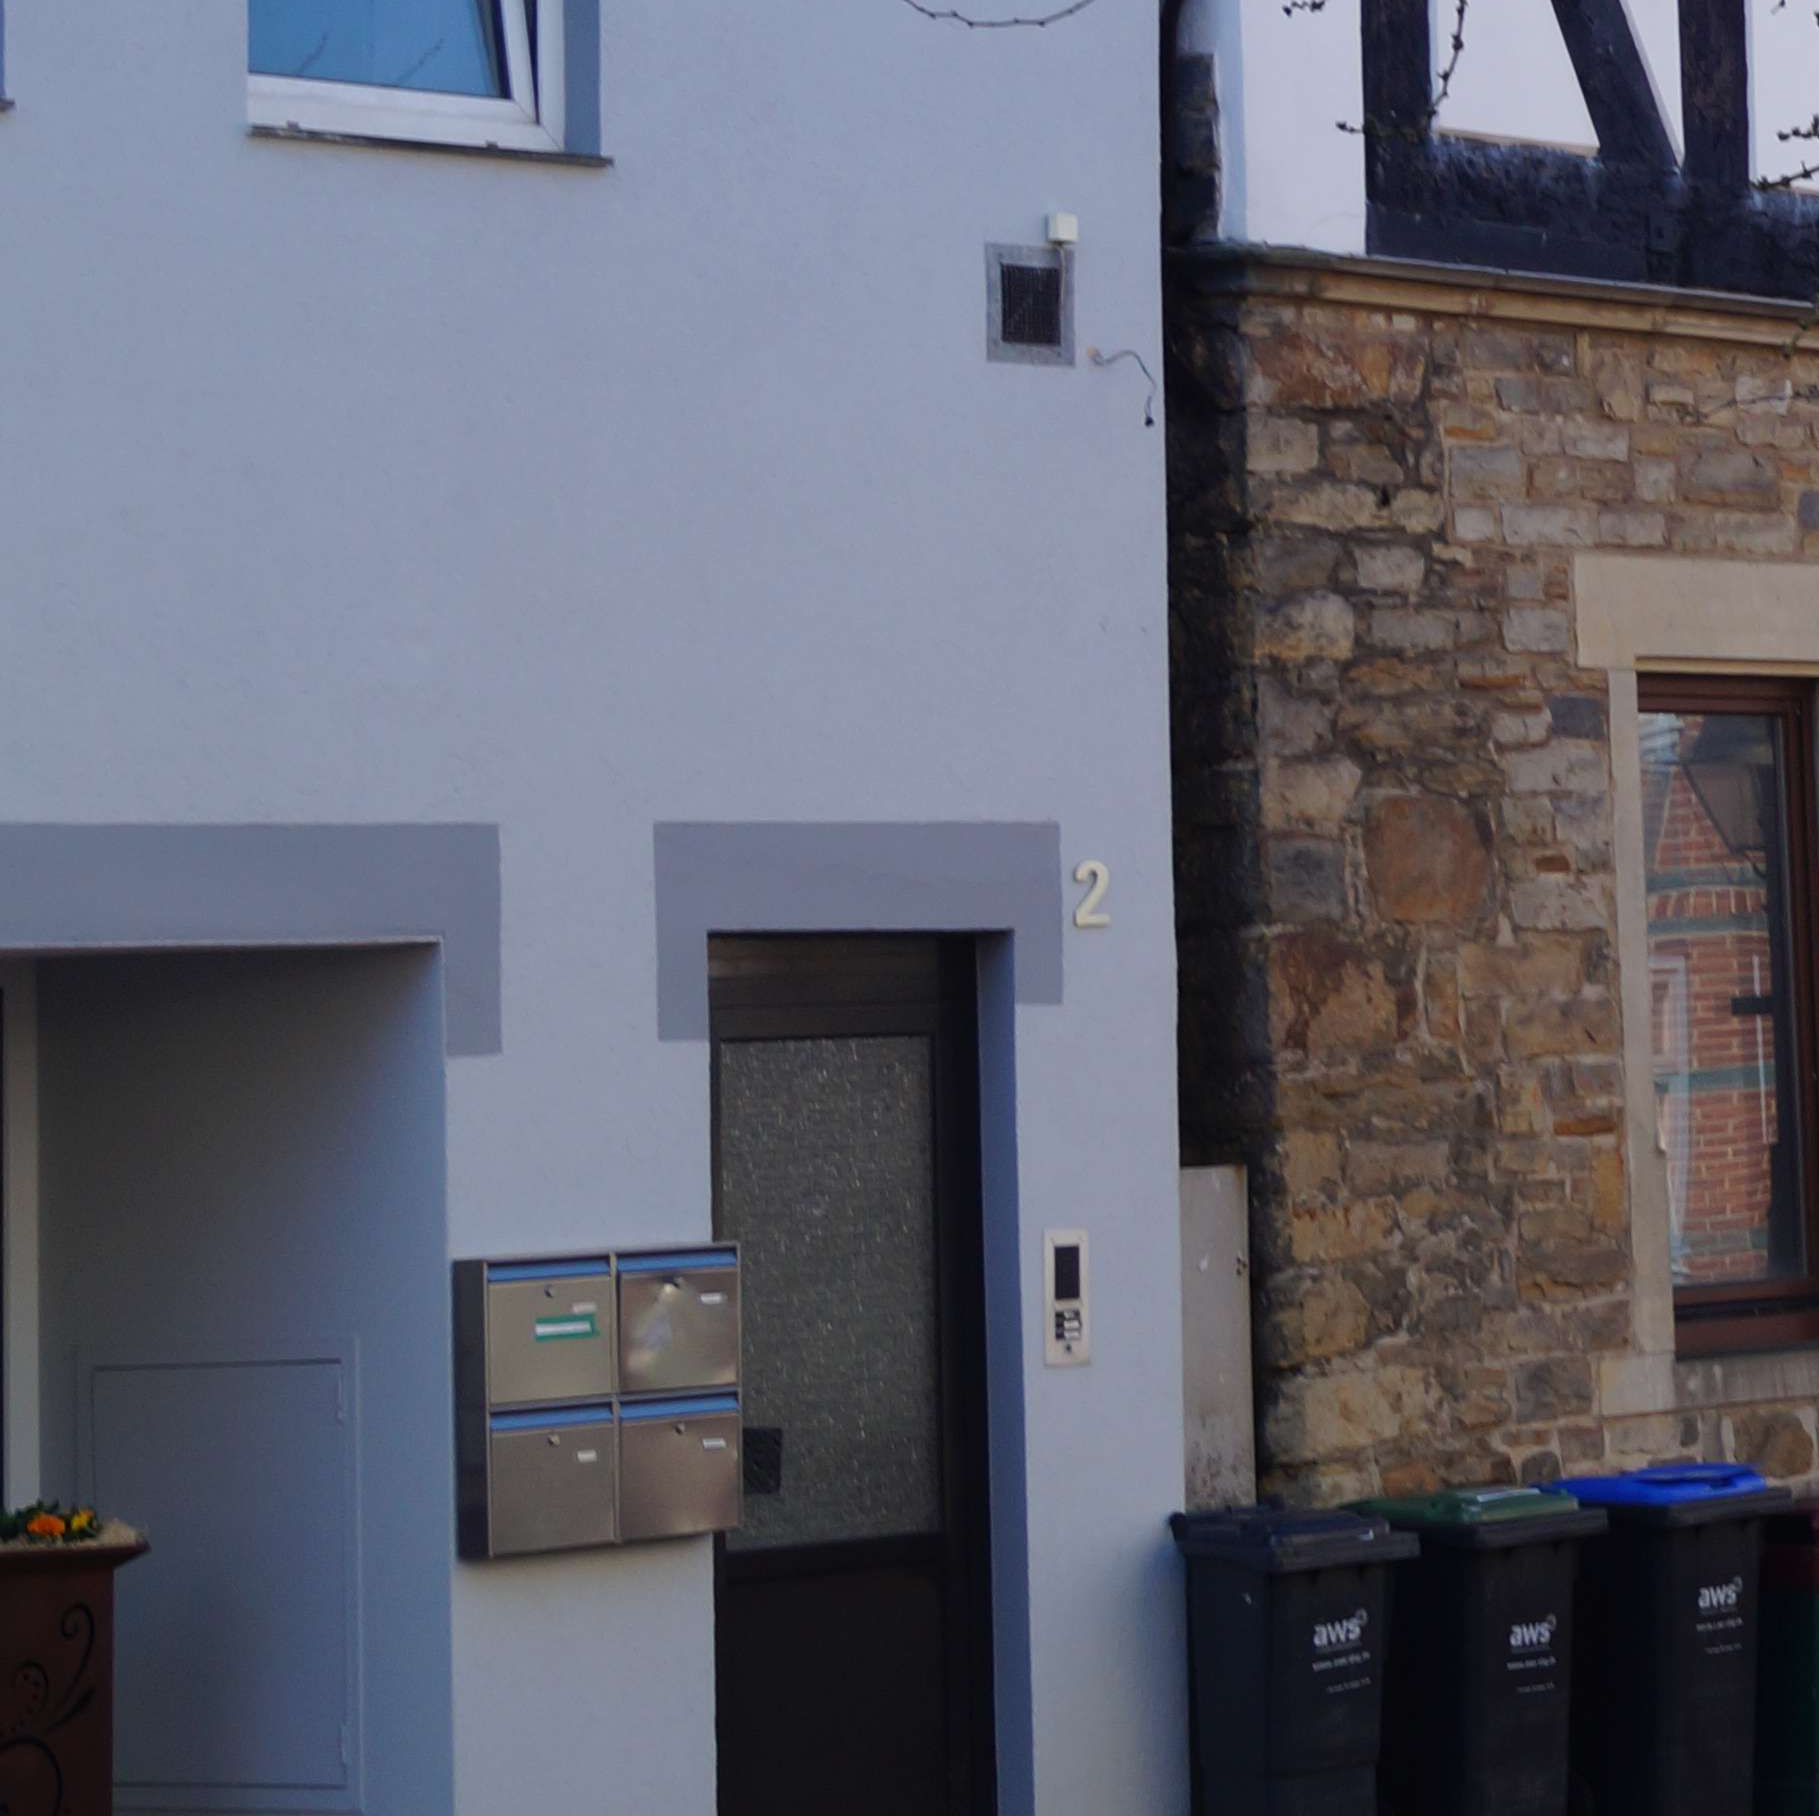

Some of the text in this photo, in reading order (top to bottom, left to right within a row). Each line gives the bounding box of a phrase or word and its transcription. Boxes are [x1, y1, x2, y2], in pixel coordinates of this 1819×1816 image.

[1074, 859, 1110, 928] 2
[1698, 1584, 1737, 1609] aws
[1313, 1617, 1361, 1648] aws
[1510, 1621, 1551, 1647] aws
